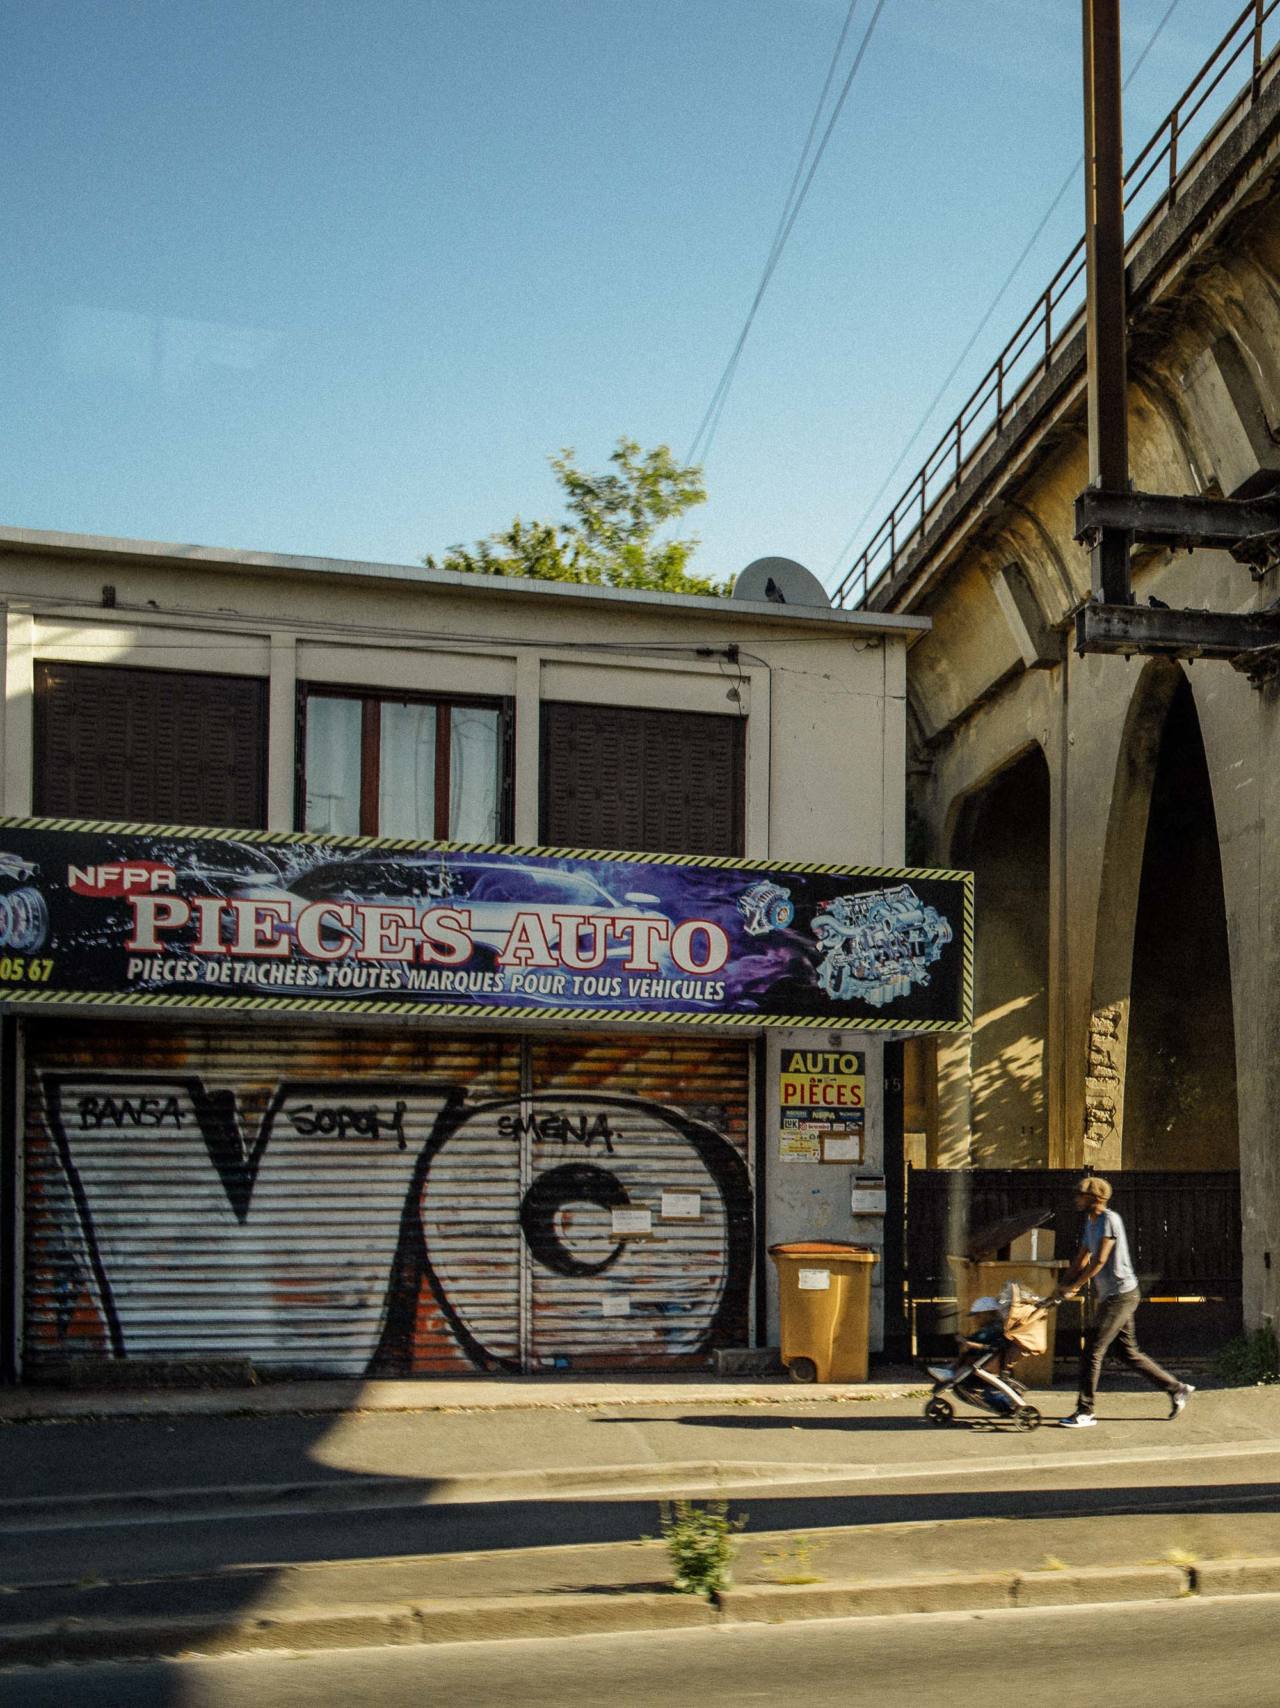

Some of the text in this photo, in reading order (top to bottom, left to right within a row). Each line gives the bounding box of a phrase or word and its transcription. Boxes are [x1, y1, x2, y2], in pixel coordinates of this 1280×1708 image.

[67, 863, 177, 891] NFPA
[124, 895, 730, 975] PIECES AUTO
[28, 959, 55, 982] 67
[326, 965, 402, 989] TOUTES
[407, 969, 505, 994] MARQUES
[510, 973, 566, 995] POUR
[572, 976, 622, 997] TOUS
[788, 1052, 858, 1074] AUTO
